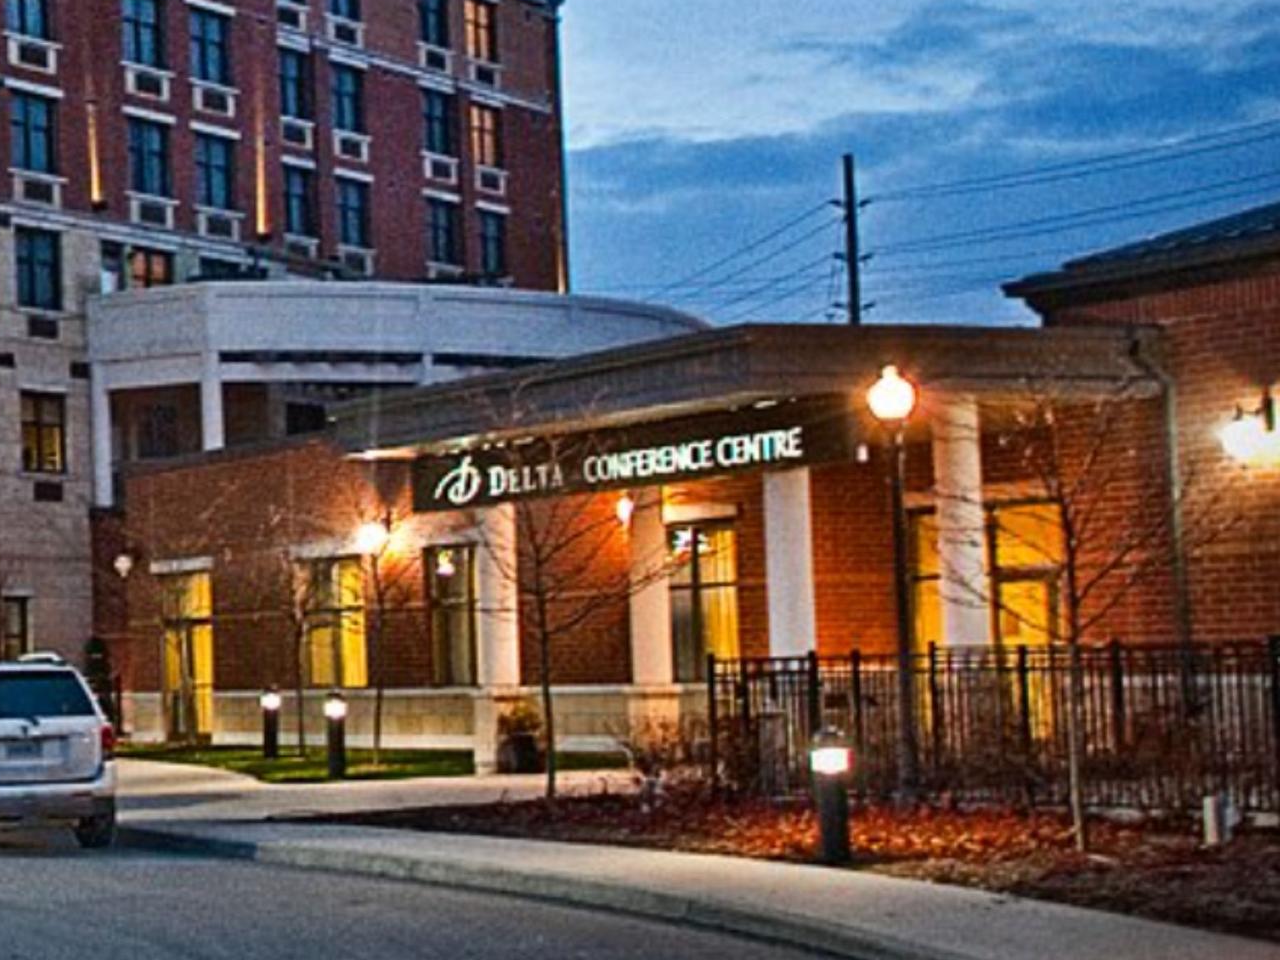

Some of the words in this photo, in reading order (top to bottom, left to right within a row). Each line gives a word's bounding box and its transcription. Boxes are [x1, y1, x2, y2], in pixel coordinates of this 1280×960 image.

[487, 463, 564, 496] DELTA
[583, 440, 714, 483] CONFERENCE
[716, 426, 803, 466] CENTRE
